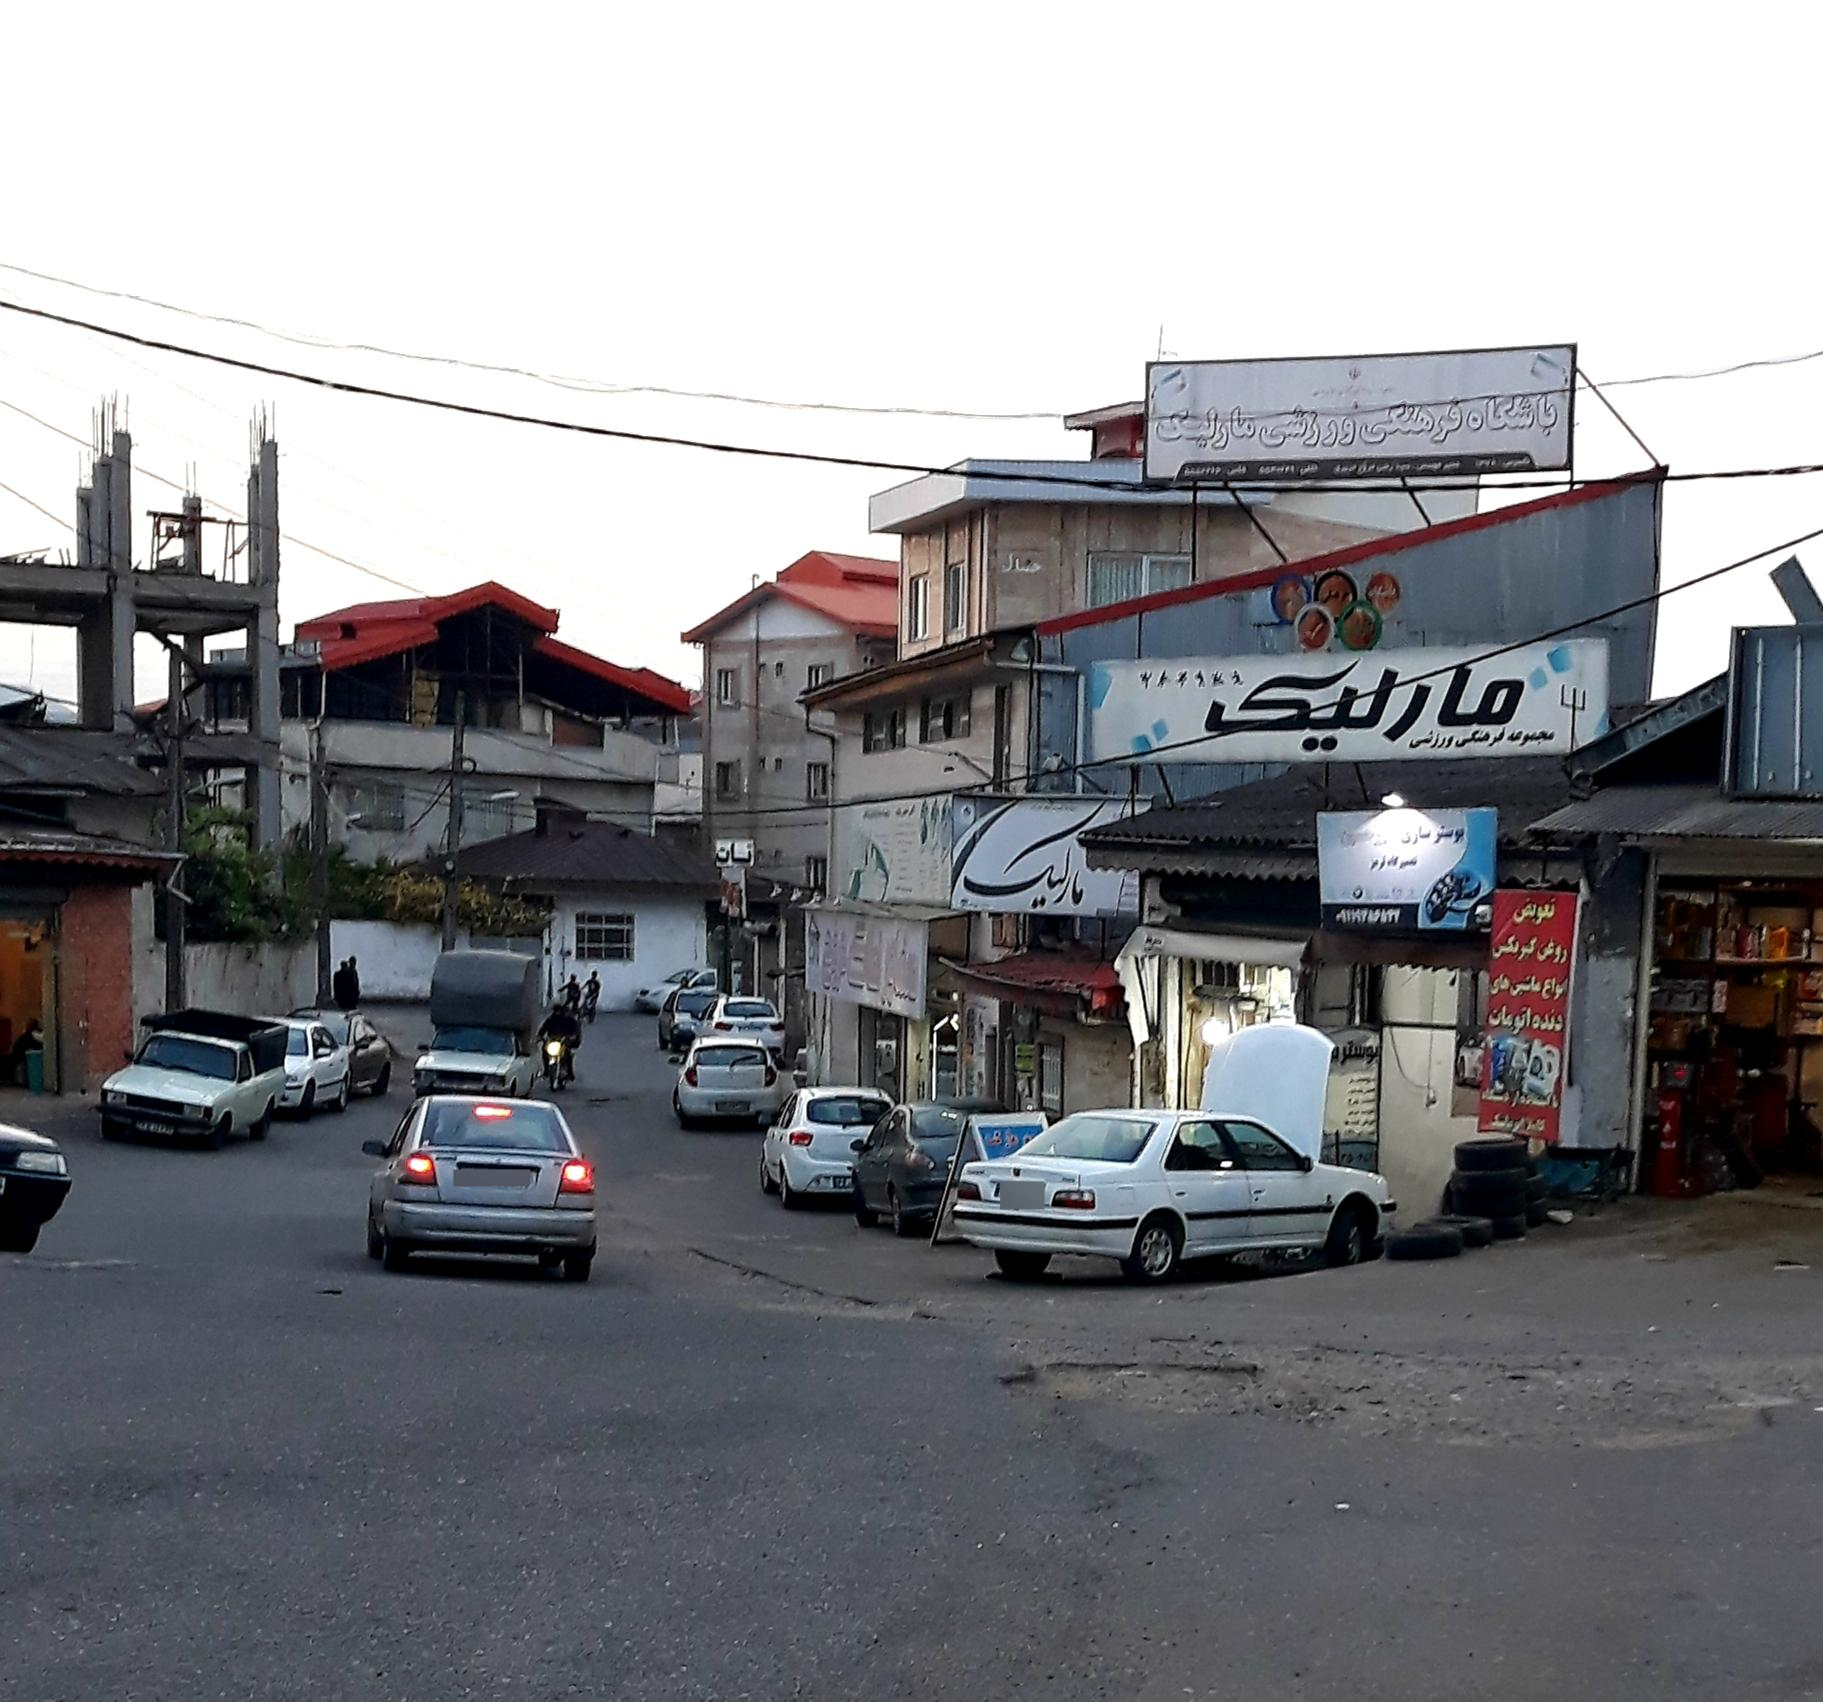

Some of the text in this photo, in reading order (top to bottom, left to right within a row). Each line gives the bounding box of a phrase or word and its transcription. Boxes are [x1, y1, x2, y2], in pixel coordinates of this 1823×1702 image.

[1156, 404, 1256, 449] مارلیک
[1360, 400, 1463, 443] فرهنگی
[1467, 395, 1557, 436] باشگاه
[1204, 658, 1526, 752] مارلیک
[1408, 727, 1556, 748] مجموعه فرهنگی ورزشی
[715, 842, 752, 863] نان
[962, 799, 1107, 909] مارلیک
[1513, 898, 1557, 925] تعویض
[1492, 934, 1567, 964] روغن گیربکس
[1541, 976, 1569, 1000] انواع
[1531, 1008, 1563, 1033] دنده
